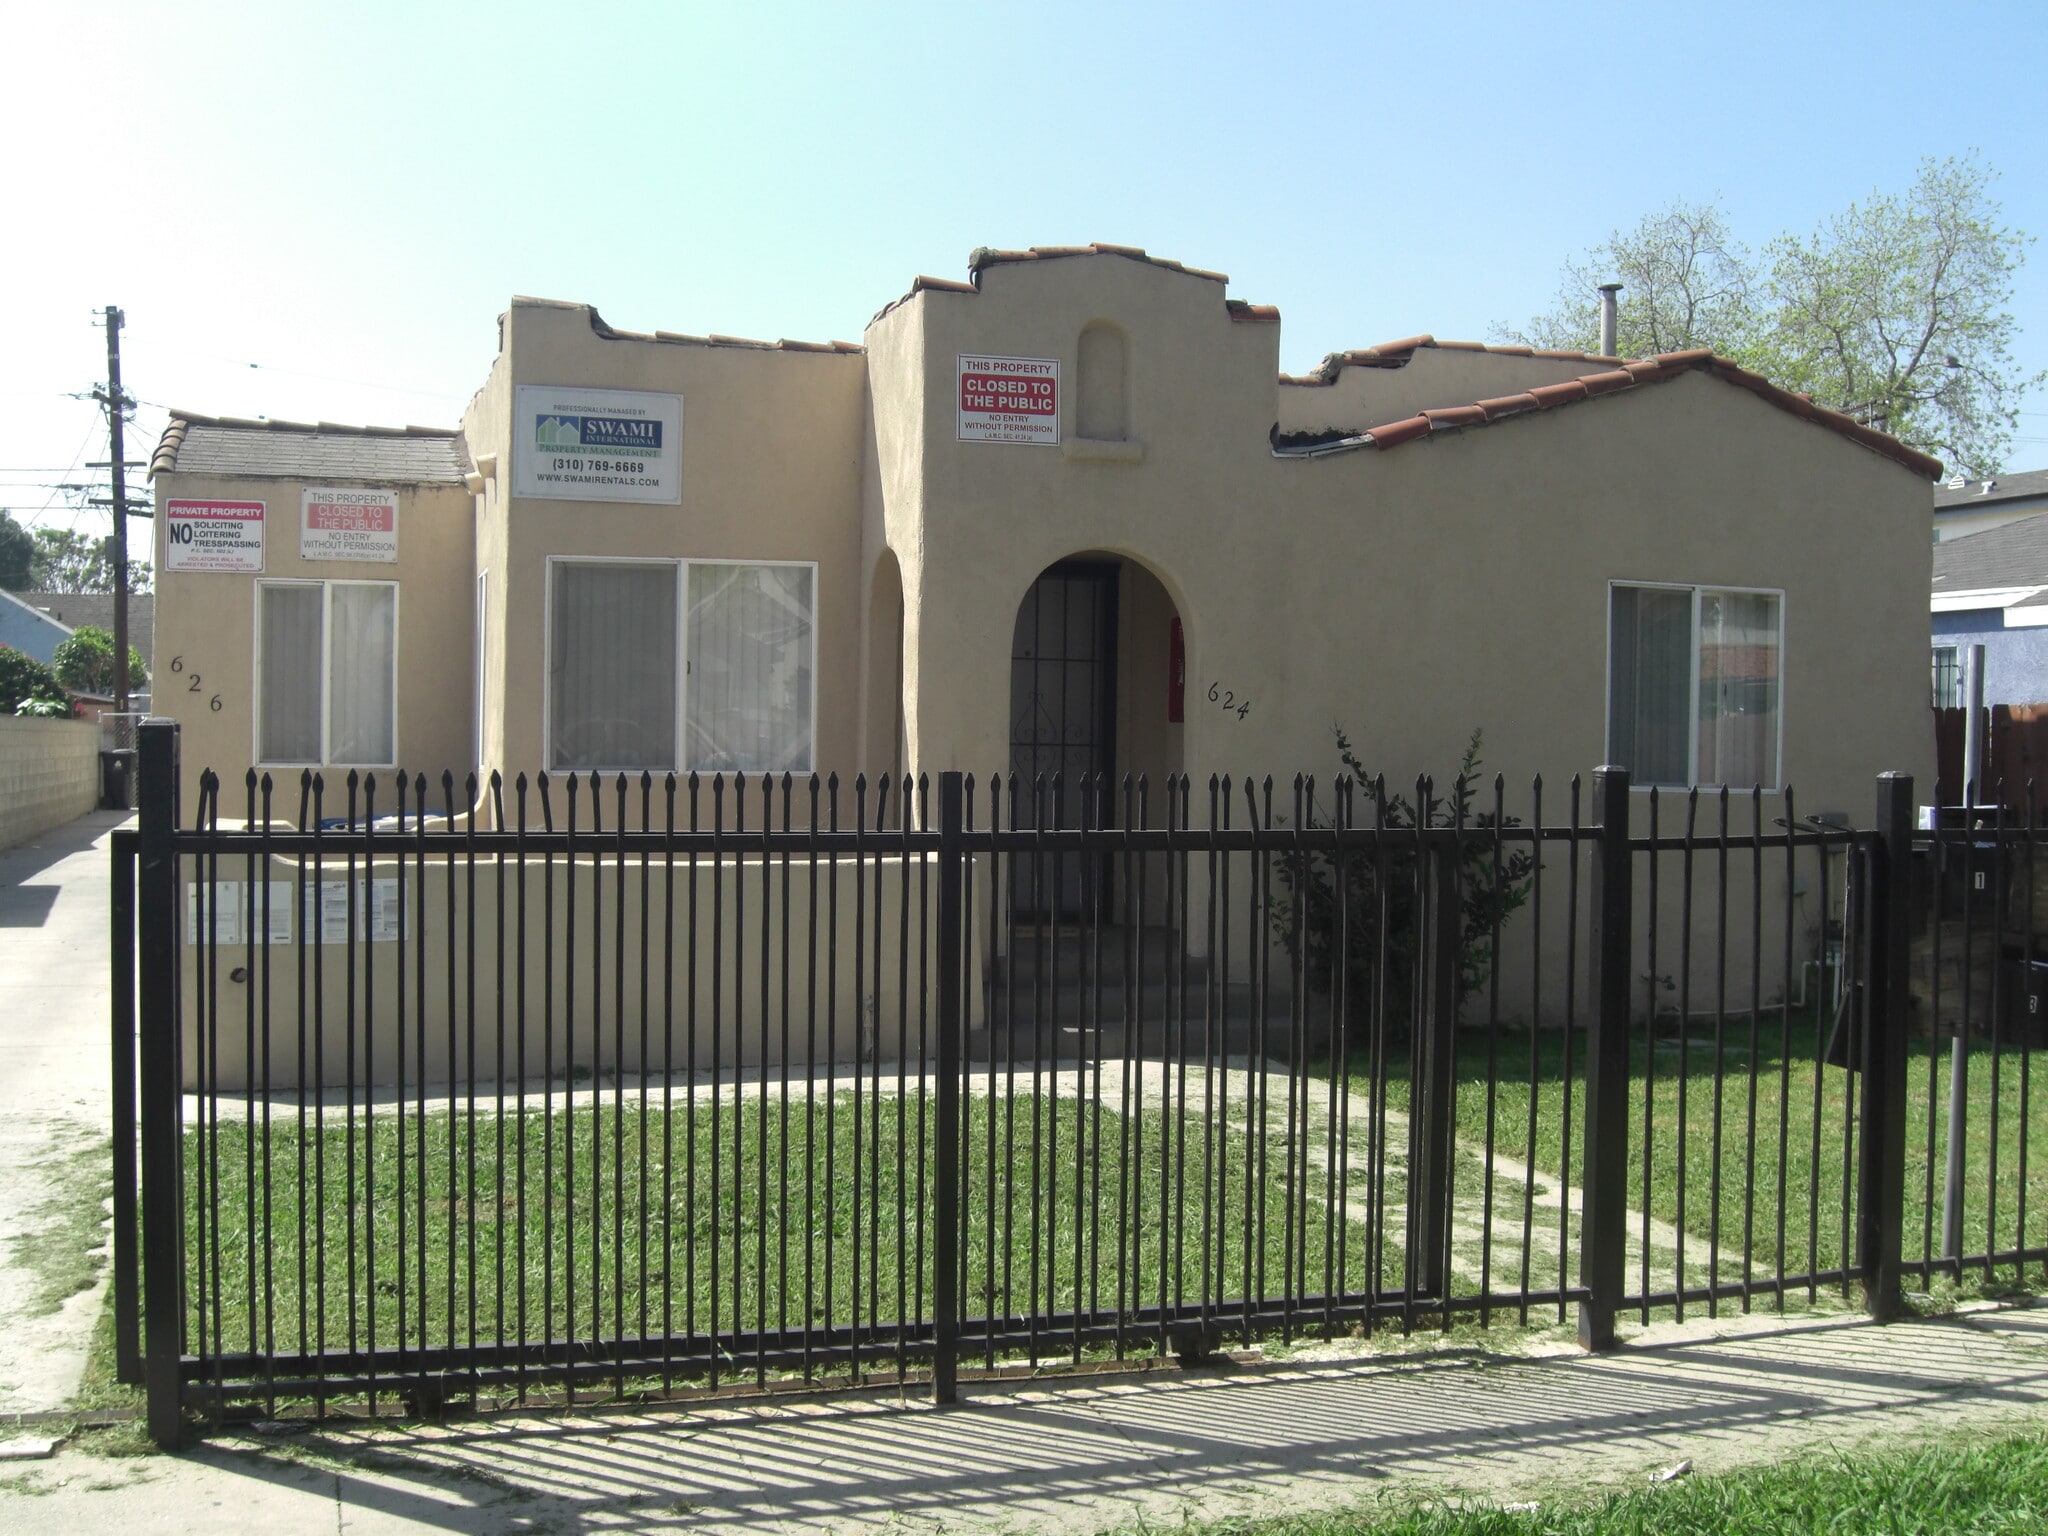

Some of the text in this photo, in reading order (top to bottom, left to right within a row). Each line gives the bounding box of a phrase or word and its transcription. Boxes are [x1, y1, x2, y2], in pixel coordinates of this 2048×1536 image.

[966, 361, 1051, 374] THIS PROPERTY
[966, 379, 1051, 395] CLOSED TO
[965, 394, 1052, 411] THE PUBLIC
[553, 404, 607, 414] PROFESSIONALLY
[607, 407, 638, 416] MANAGED
[1003, 414, 1029, 423] ENTRY
[586, 420, 655, 437] SWAMI
[965, 422, 1053, 433] WITHOUT PERMISSION
[586, 435, 657, 445] INTERNATIONAL
[539, 444, 659, 459] PROPERTY MANAGEMENT
[552, 458, 645, 474] (310) 769-6669
[537, 473, 660, 488] WWW.SWAMIRENTALS.COM
[312, 492, 390, 505] THIS PROPERTY
[169, 507, 262, 516] PRIVATE PROPERTY
[318, 505, 383, 518] CLOSED TO
[193, 521, 244, 529] SOLICITING
[317, 517, 383, 531] THE PUBLIC
[170, 523, 192, 544] NO
[193, 530, 241, 539] LOITERING
[328, 532, 371, 542] NO ENTRY
[193, 540, 261, 548] TRESSPASSING
[303, 540, 396, 551] WITHOUT PERMISSION
[171, 655, 222, 712] 626
[1207, 681, 1250, 721] 624
